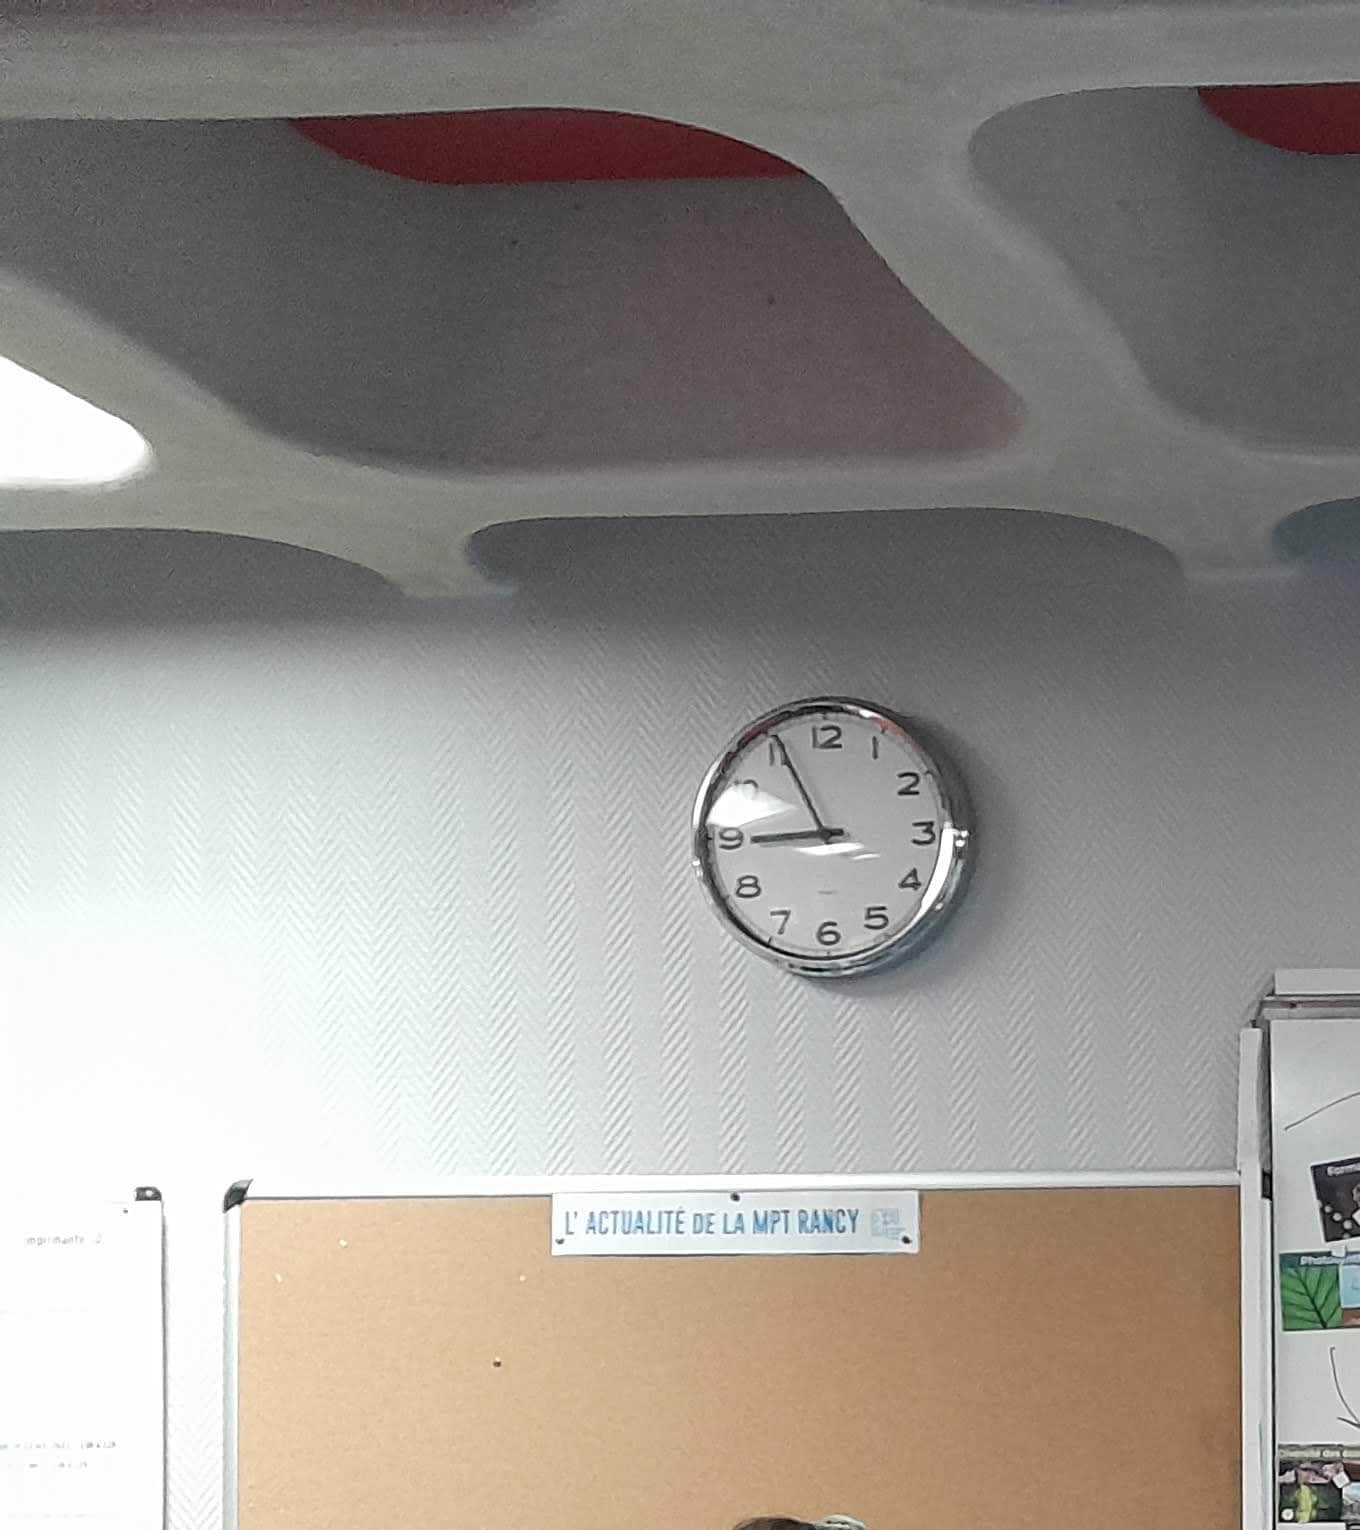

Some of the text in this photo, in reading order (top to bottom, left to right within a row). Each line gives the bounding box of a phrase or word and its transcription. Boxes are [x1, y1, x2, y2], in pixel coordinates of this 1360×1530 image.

[811, 725, 843, 750] 12
[871, 735, 879, 760] 1
[768, 738, 790, 767] 11
[897, 772, 921, 796] 2
[718, 829, 745, 850] 9
[912, 821, 936, 845] 3
[736, 875, 762, 899] 8
[898, 867, 921, 891] 4
[770, 909, 791, 934] 7
[864, 906, 888, 930] 5
[817, 921, 841, 946] 6
[585, 1206, 686, 1236] ACTUALITÉ
[691, 1210, 717, 1235] DE
[722, 1211, 747, 1235] LA
[752, 1209, 790, 1235] MPT
[797, 1208, 861, 1235] RANCY
